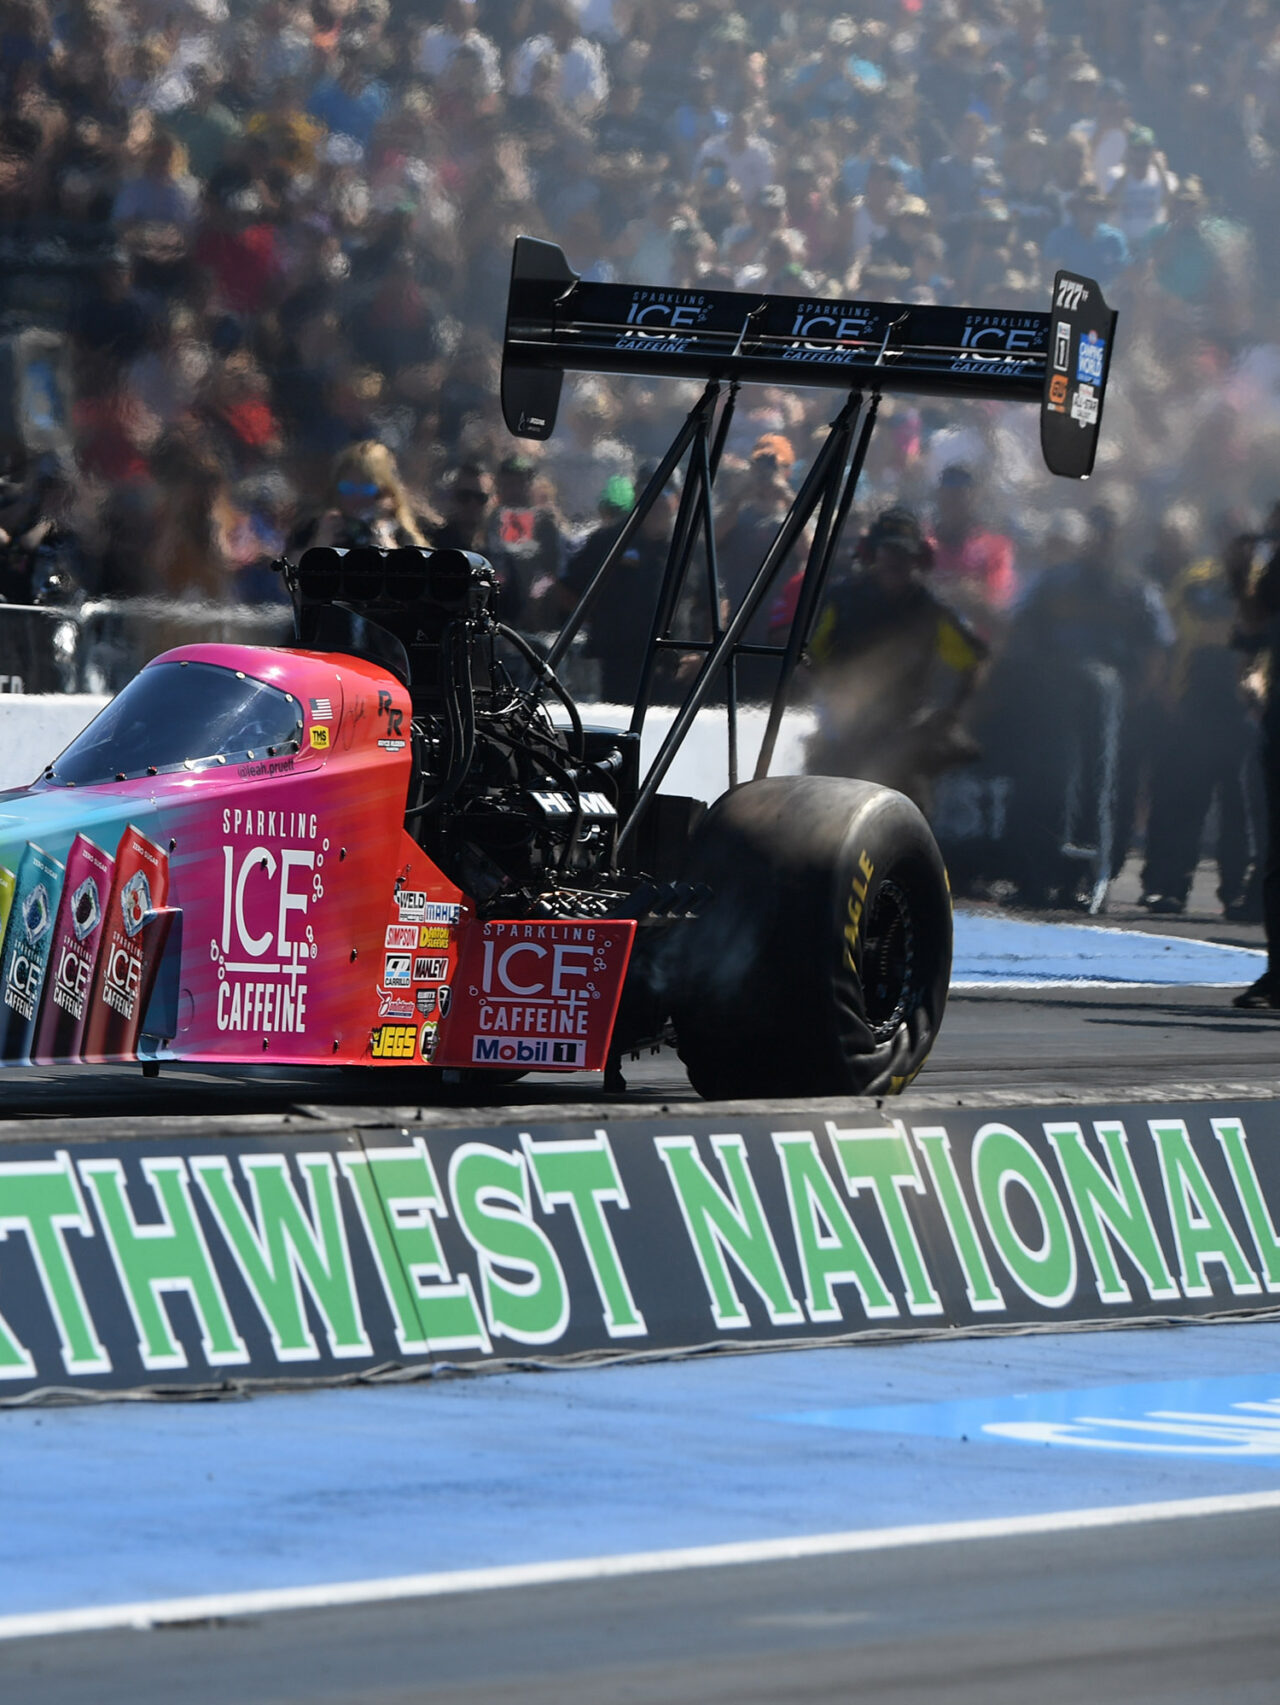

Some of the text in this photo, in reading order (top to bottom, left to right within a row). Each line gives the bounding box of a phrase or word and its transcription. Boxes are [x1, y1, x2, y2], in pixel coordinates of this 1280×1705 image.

[633, 291, 705, 305] SPARKLING
[1056, 279, 1084, 311] 777
[625, 303, 702, 342] ICE
[798, 303, 870, 318] SPARKLING
[966, 315, 1040, 329] SPARKLING
[615, 339, 692, 353] CAFFEINE
[791, 315, 867, 352] ICE
[959, 327, 1037, 365] ICE
[782, 350, 856, 364] CAFFEINE
[950, 361, 1024, 376] CAFFEINE
[312, 730, 327, 741] TMS
[223, 808, 317, 838] SPARKLING
[81, 849, 108, 872] ZERO SUGAR
[132, 841, 159, 866] ZERO SUGAR
[33, 858, 58, 880] ZERO SUGAR
[222, 846, 316, 958] ICE
[400, 892, 425, 909] WELD
[387, 927, 417, 946] SIMPSON
[483, 923, 596, 941] SPARKLING
[8, 950, 42, 995] ICE
[57, 946, 90, 995] ICE
[106, 943, 141, 993] ICE
[482, 940, 594, 998] ICE
[4, 988, 34, 1021] CAFFEINE
[53, 987, 83, 1021] CAFFEINE
[102, 984, 134, 1021] CAFFEINE
[217, 981, 307, 1033] CAFFEINE
[479, 1006, 589, 1034] CAFFEINE
[372, 1026, 418, 1057] JEGS
[476, 1039, 548, 1062] Mobil
[654, 1117, 1280, 1330] NATIONAL
